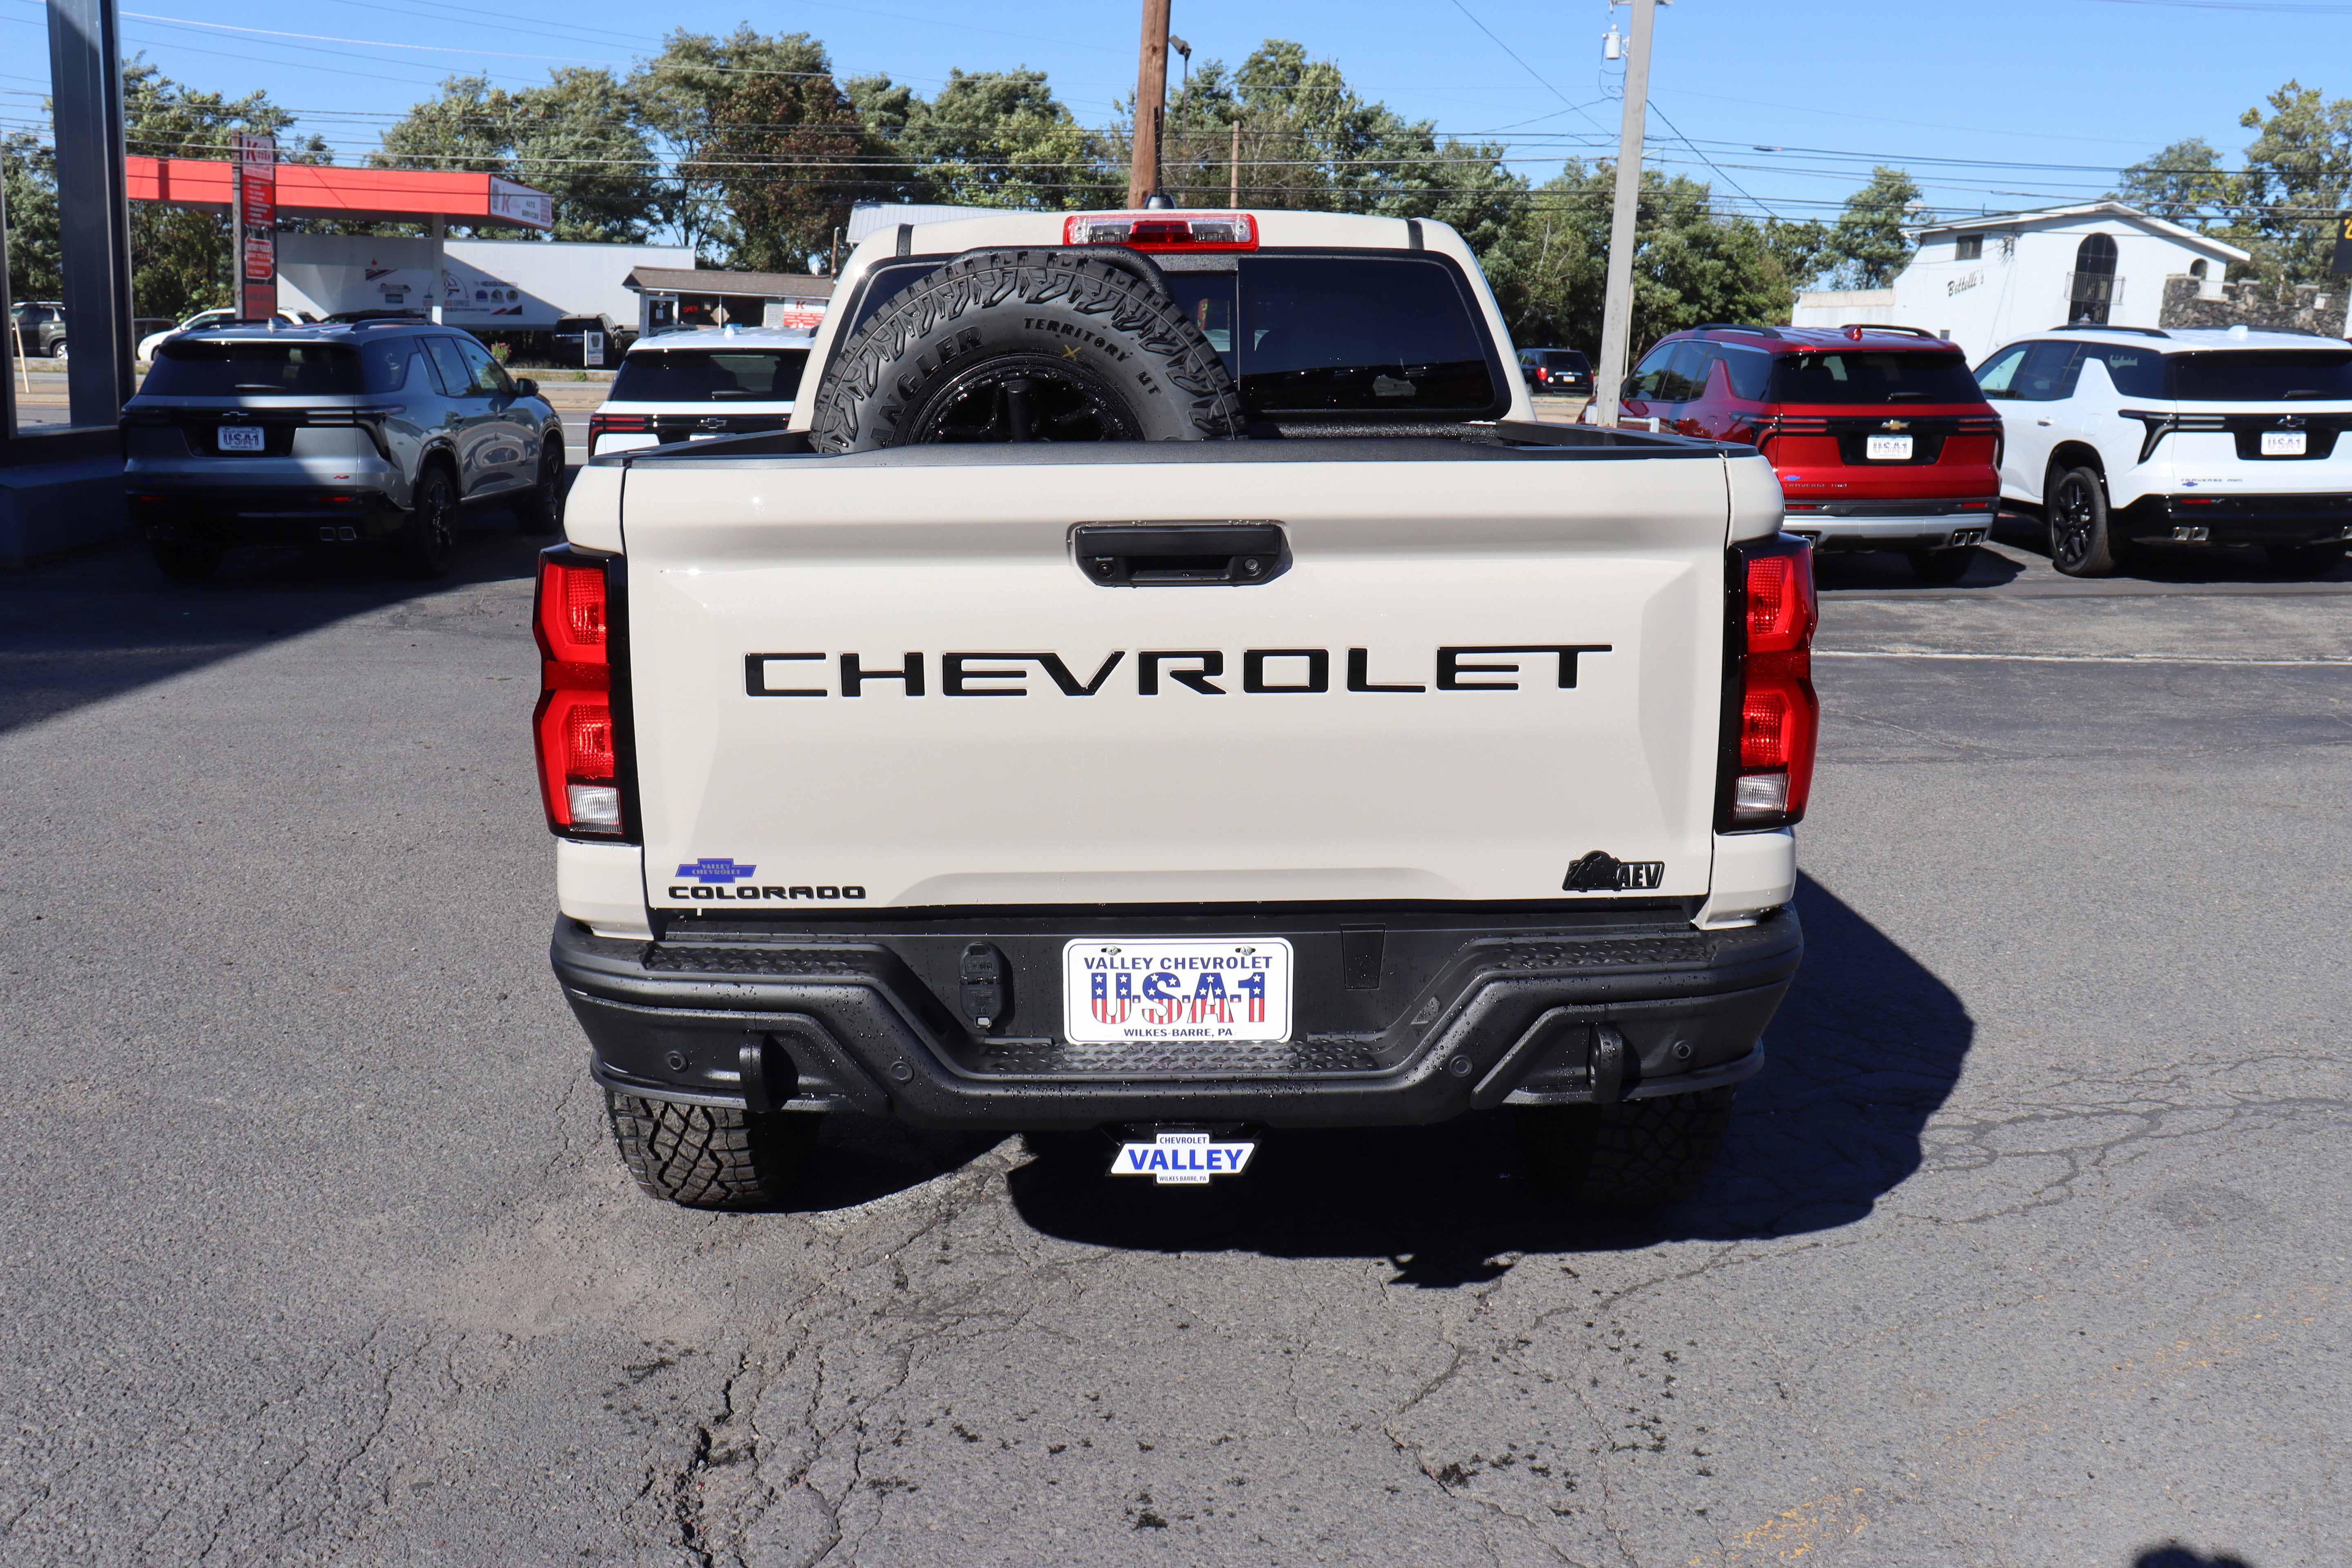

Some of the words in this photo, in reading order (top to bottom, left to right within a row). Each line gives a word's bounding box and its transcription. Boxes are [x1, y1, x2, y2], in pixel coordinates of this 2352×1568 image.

[1024, 318, 1130, 362] TERRITORY
[1136, 371, 1161, 394] MT
[745, 644, 1613, 697] CHEVROLET
[1618, 864, 1661, 887] AEV
[668, 886, 866, 900] COLORADO
[1084, 957, 1154, 969] VALLEY
[1160, 956, 1273, 969] CHEVROLET
[1123, 1029, 1215, 1038] WILKES-BARRE,
[1218, 1028, 1233, 1036] PA
[1128, 1149, 1244, 1170] VALLEY
